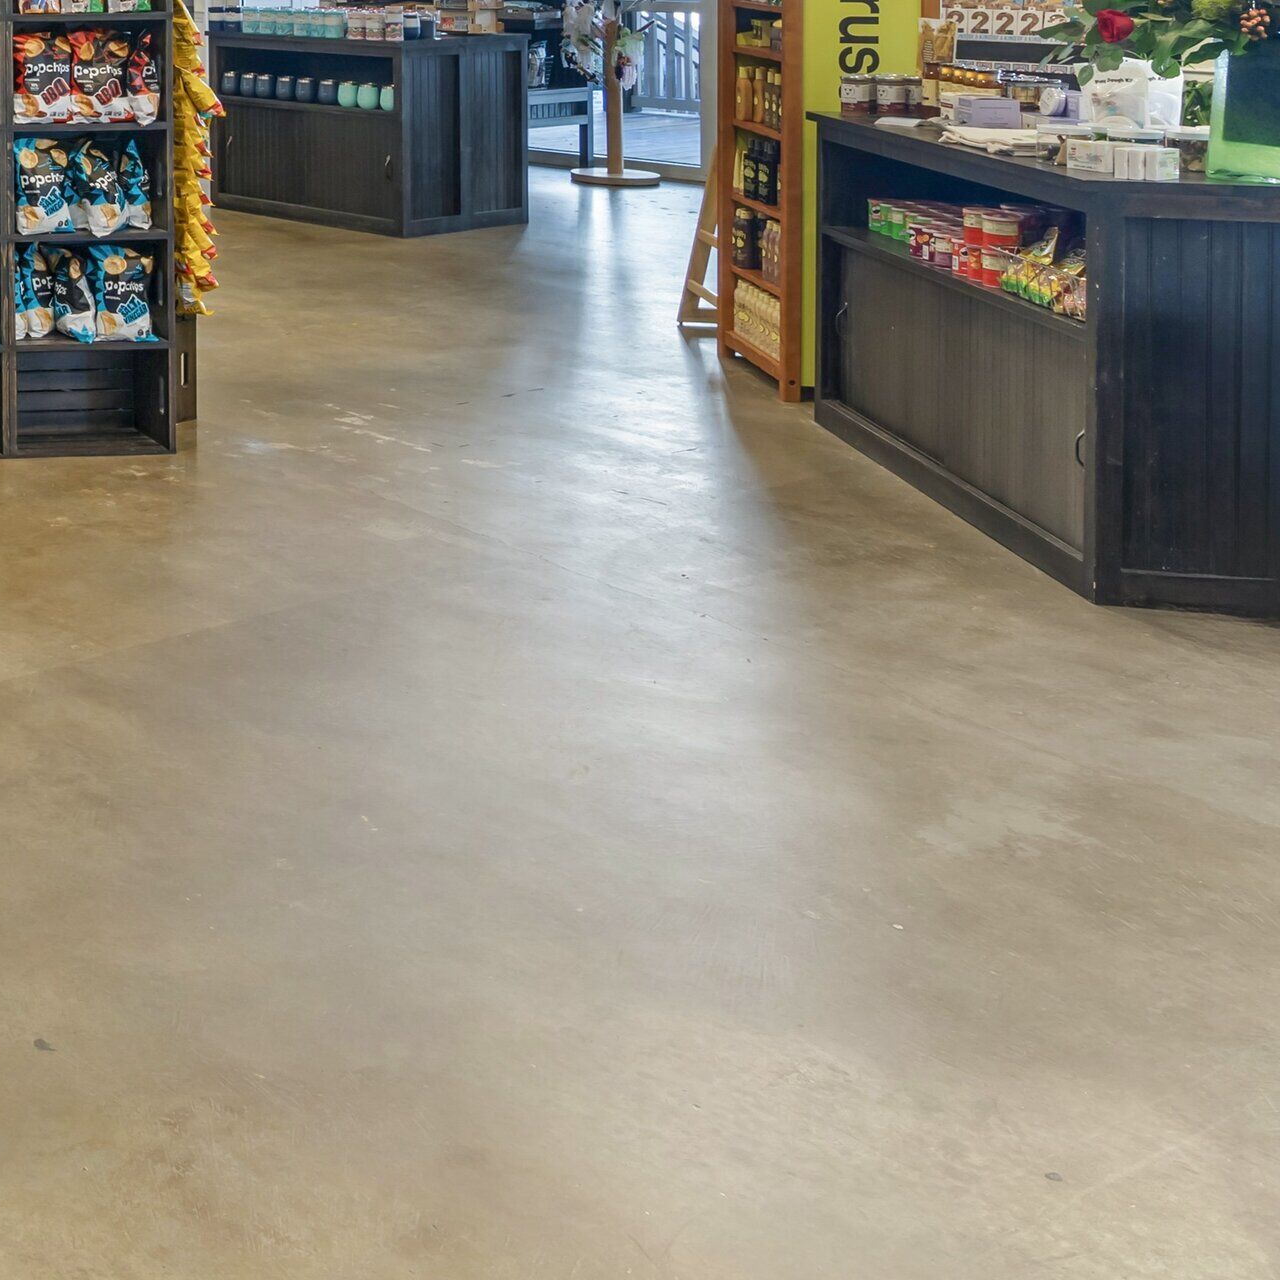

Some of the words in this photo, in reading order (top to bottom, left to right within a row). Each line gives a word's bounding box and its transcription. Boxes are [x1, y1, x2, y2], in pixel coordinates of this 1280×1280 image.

[970, 11, 989, 34] 2
[995, 12, 1014, 35] 2
[1020, 13, 1039, 36] 2
[24, 62, 70, 77] popchips
[74, 64, 122, 78] popchips
[39, 77, 71, 106] BBQ
[94, 78, 122, 107] BBQ
[104, 280, 144, 295] popchips
